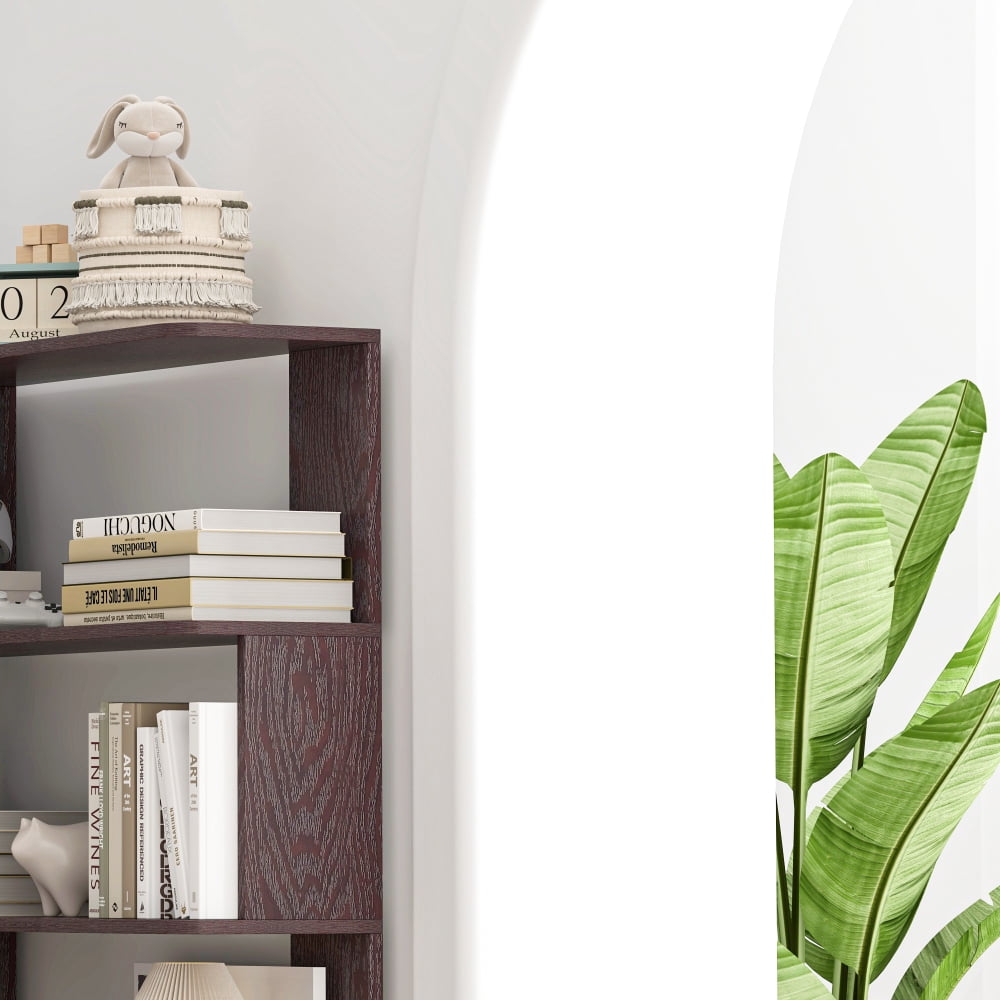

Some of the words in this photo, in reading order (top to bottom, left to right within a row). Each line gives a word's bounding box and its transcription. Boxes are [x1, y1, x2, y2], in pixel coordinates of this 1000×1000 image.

[9, 328, 61, 340] August
[104, 512, 176, 536] NOGUCHI
[111, 541, 158, 556] Remodelista
[90, 741, 100, 796] FINE
[123, 754, 131, 788] ART
[190, 753, 198, 788] ART
[90, 808, 100, 890] WINES
